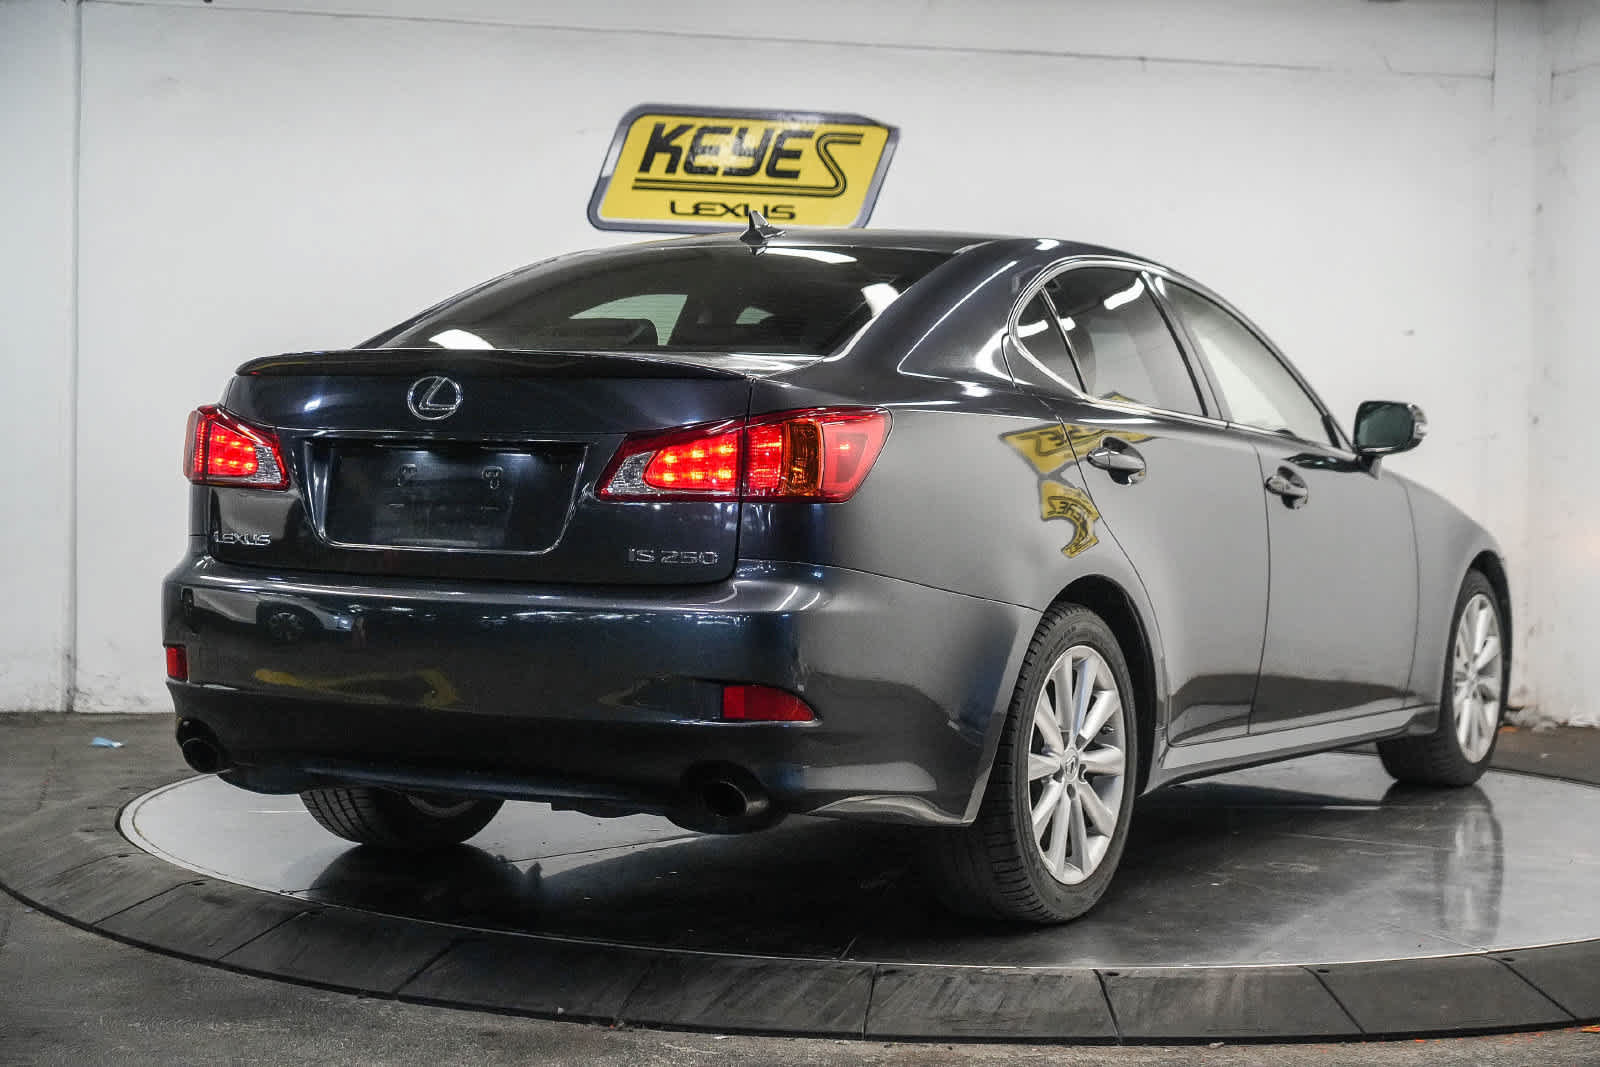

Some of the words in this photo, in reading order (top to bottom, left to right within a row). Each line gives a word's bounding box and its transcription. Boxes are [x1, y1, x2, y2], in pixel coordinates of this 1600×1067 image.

[633, 121, 865, 197] KEYES
[670, 200, 797, 220] LEXUS
[213, 530, 271, 546] LEXUS
[628, 547, 656, 563] IS
[660, 549, 719, 565] 250
